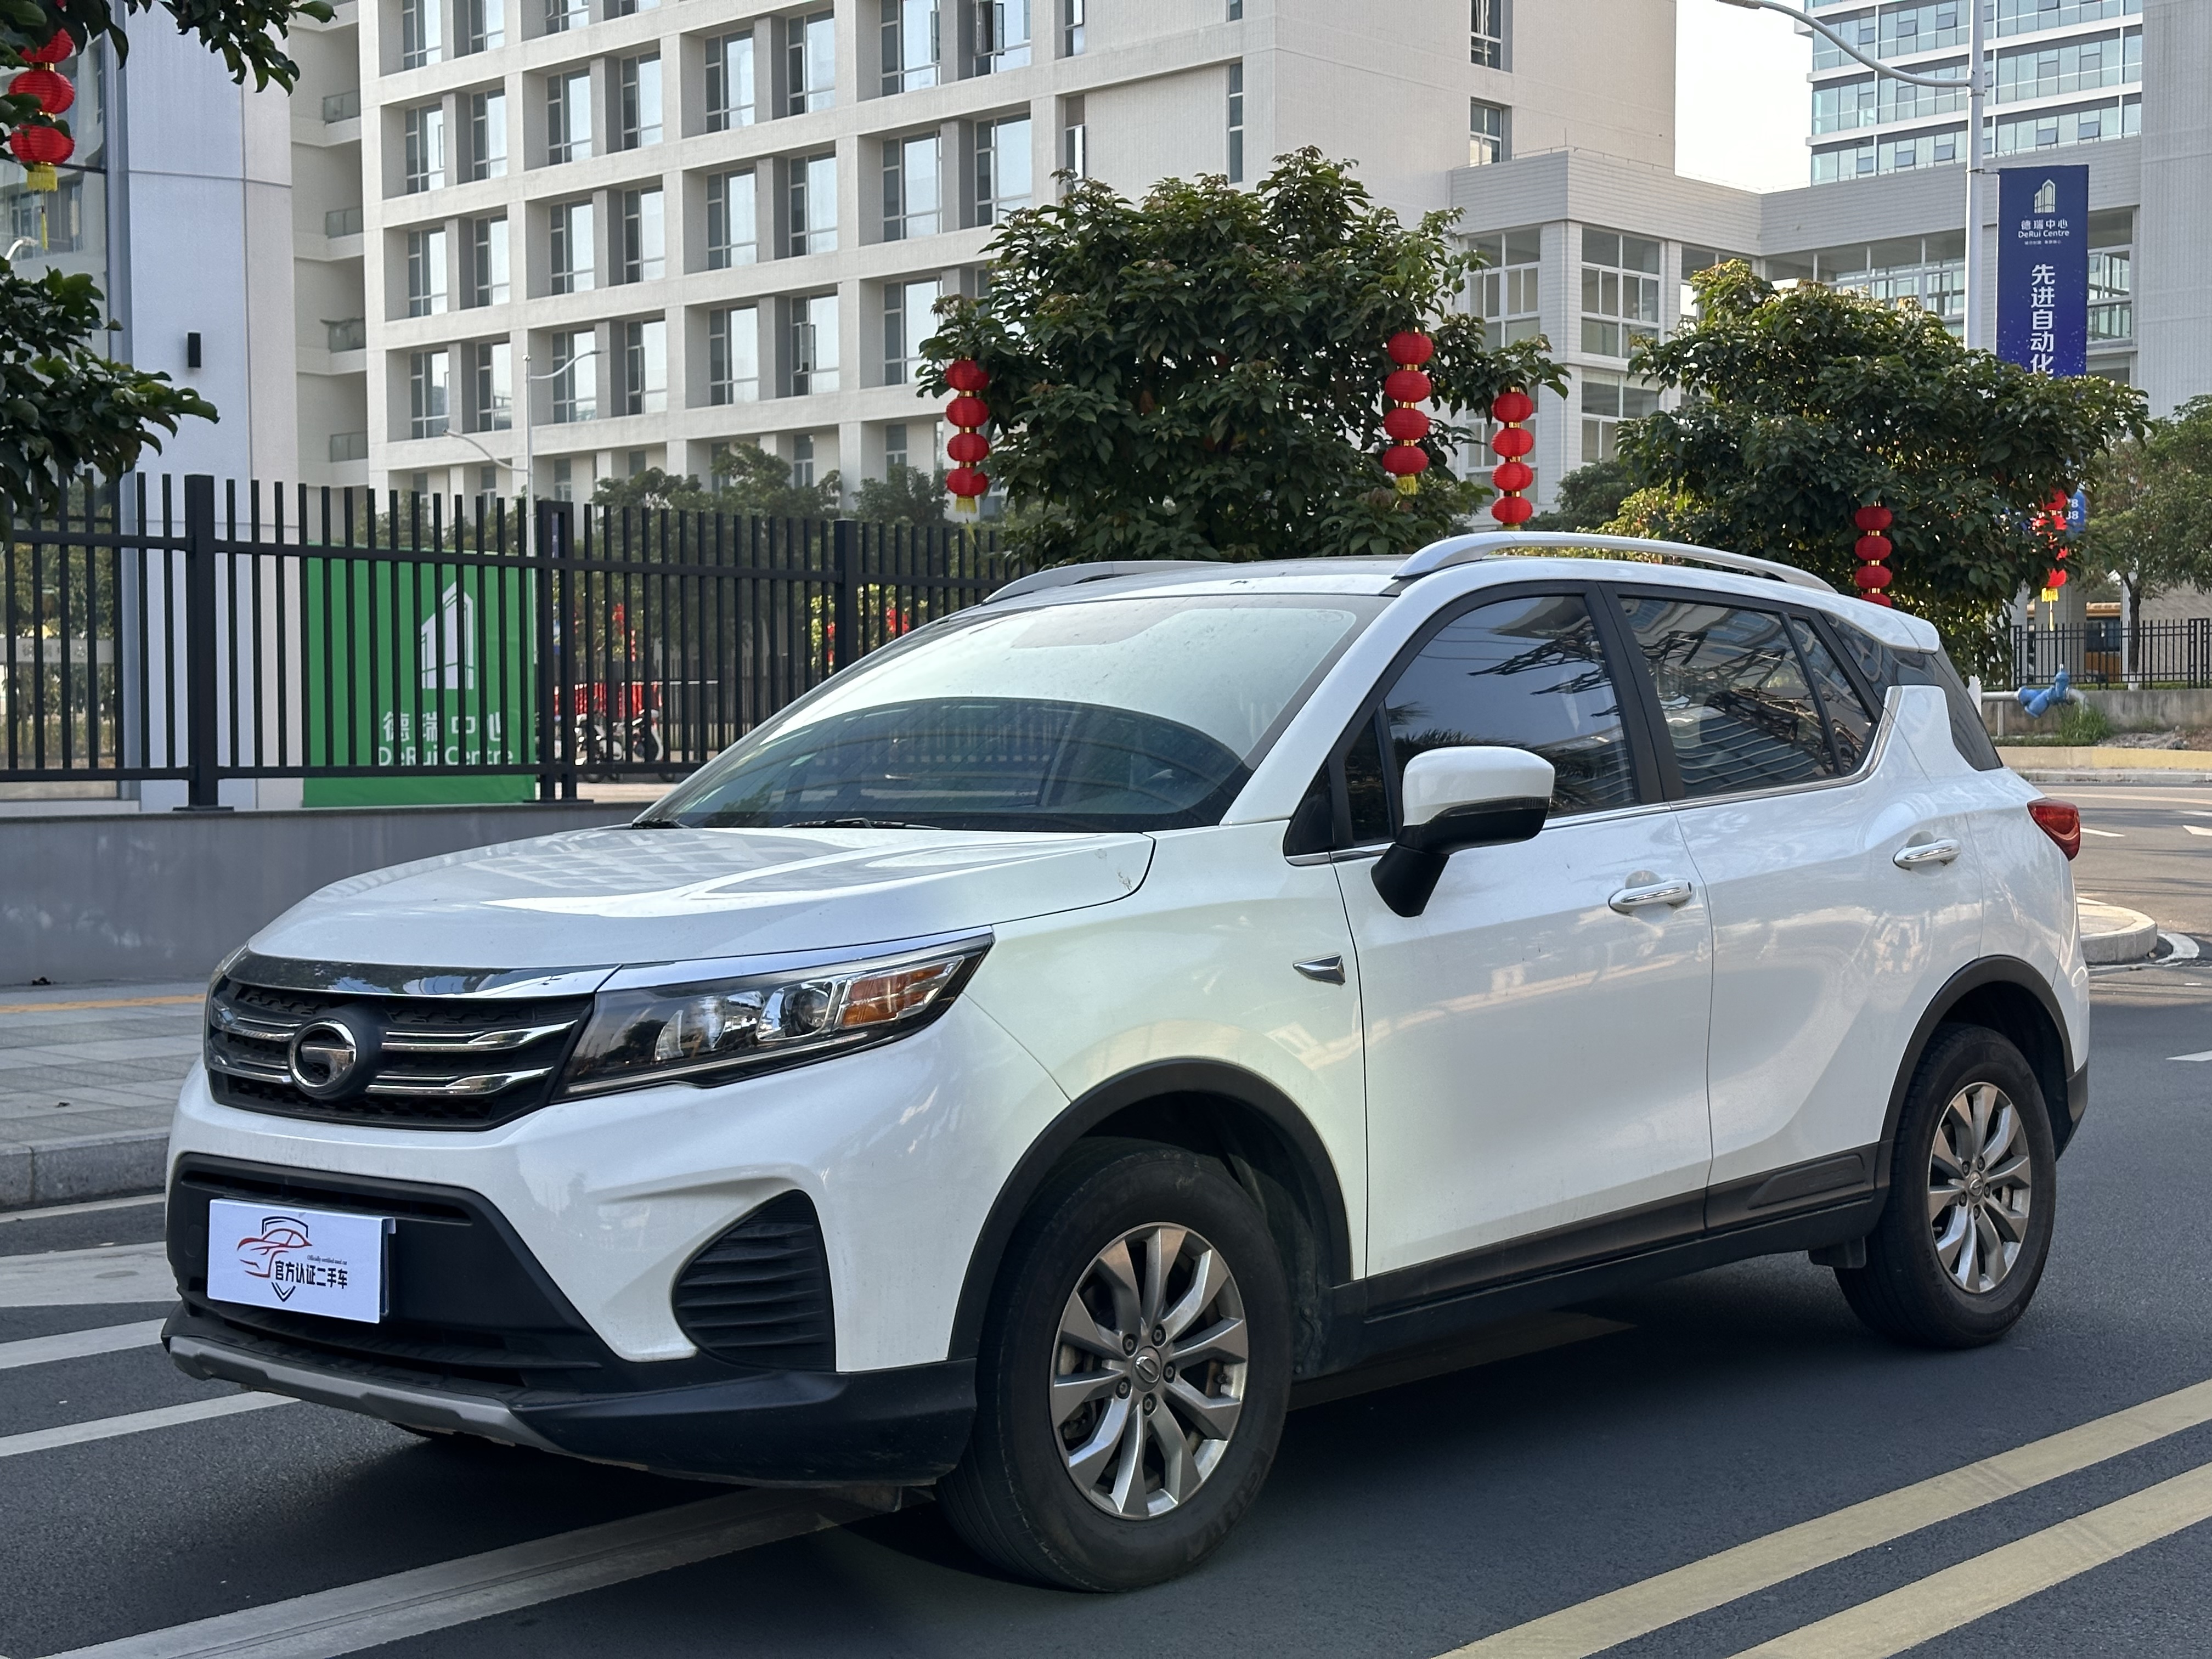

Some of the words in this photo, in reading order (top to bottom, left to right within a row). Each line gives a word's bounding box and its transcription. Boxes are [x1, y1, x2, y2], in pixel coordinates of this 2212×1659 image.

[2021, 219, 2068, 230] 德瑞中心
[2030, 264, 2055, 376] 先进自动化
[275, 1260, 348, 1289] 官方认证二手车
